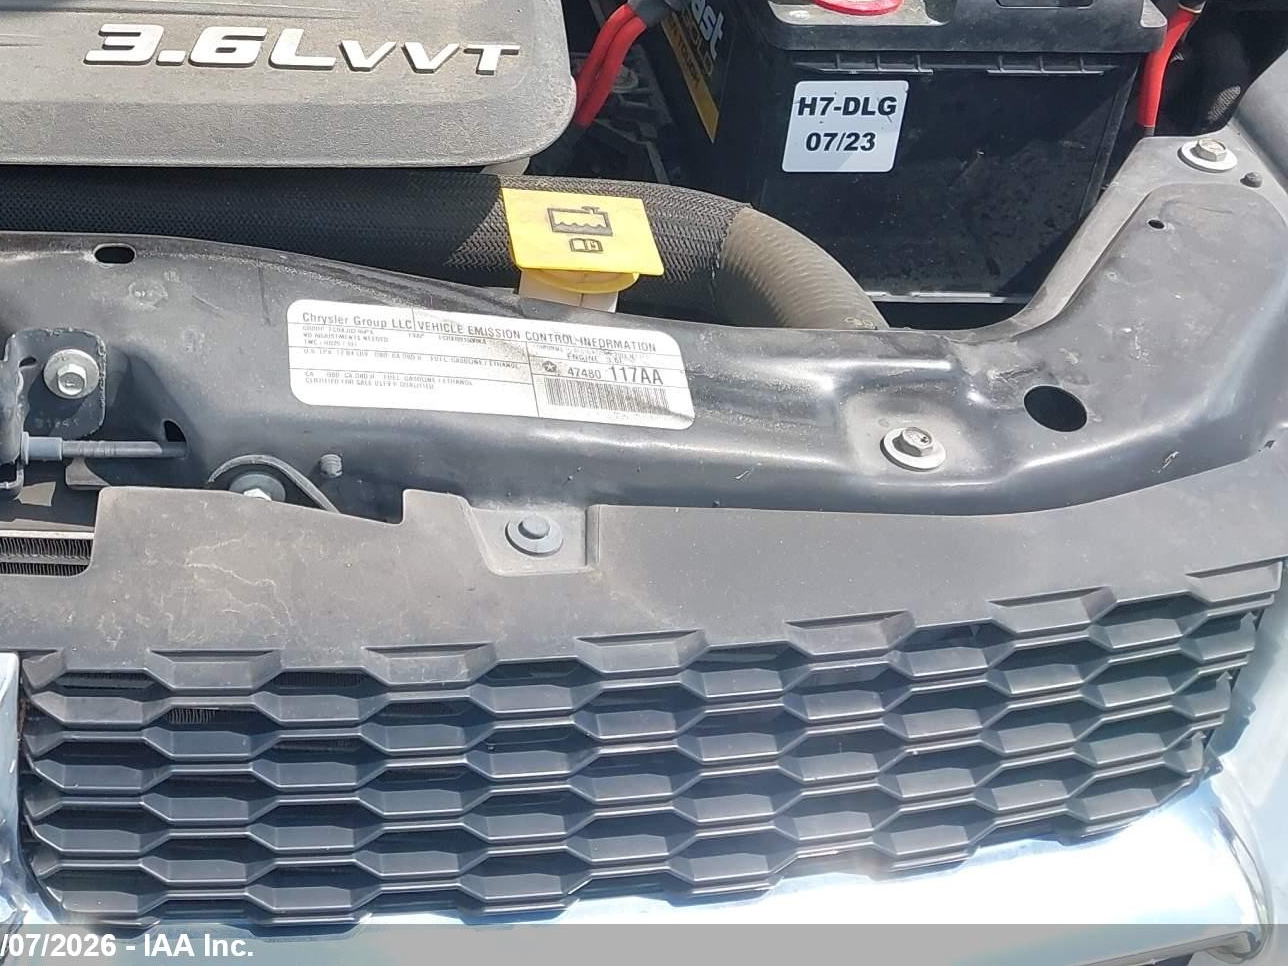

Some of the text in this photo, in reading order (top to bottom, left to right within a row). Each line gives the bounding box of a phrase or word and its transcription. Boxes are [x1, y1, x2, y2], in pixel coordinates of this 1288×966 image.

[797, 96, 897, 117] H7-DLG
[805, 131, 877, 152] 07/23
[302, 312, 349, 326] Chrysler
[353, 315, 388, 328] Group
[391, 318, 413, 330] LLC
[417, 320, 464, 334] VEHICLE
[467, 325, 521, 340] EMISSION
[525, 331, 577, 345] CONTROL
[582, 337, 657, 352] INFORMATION
[567, 366, 664, 385] 47480 117AA
